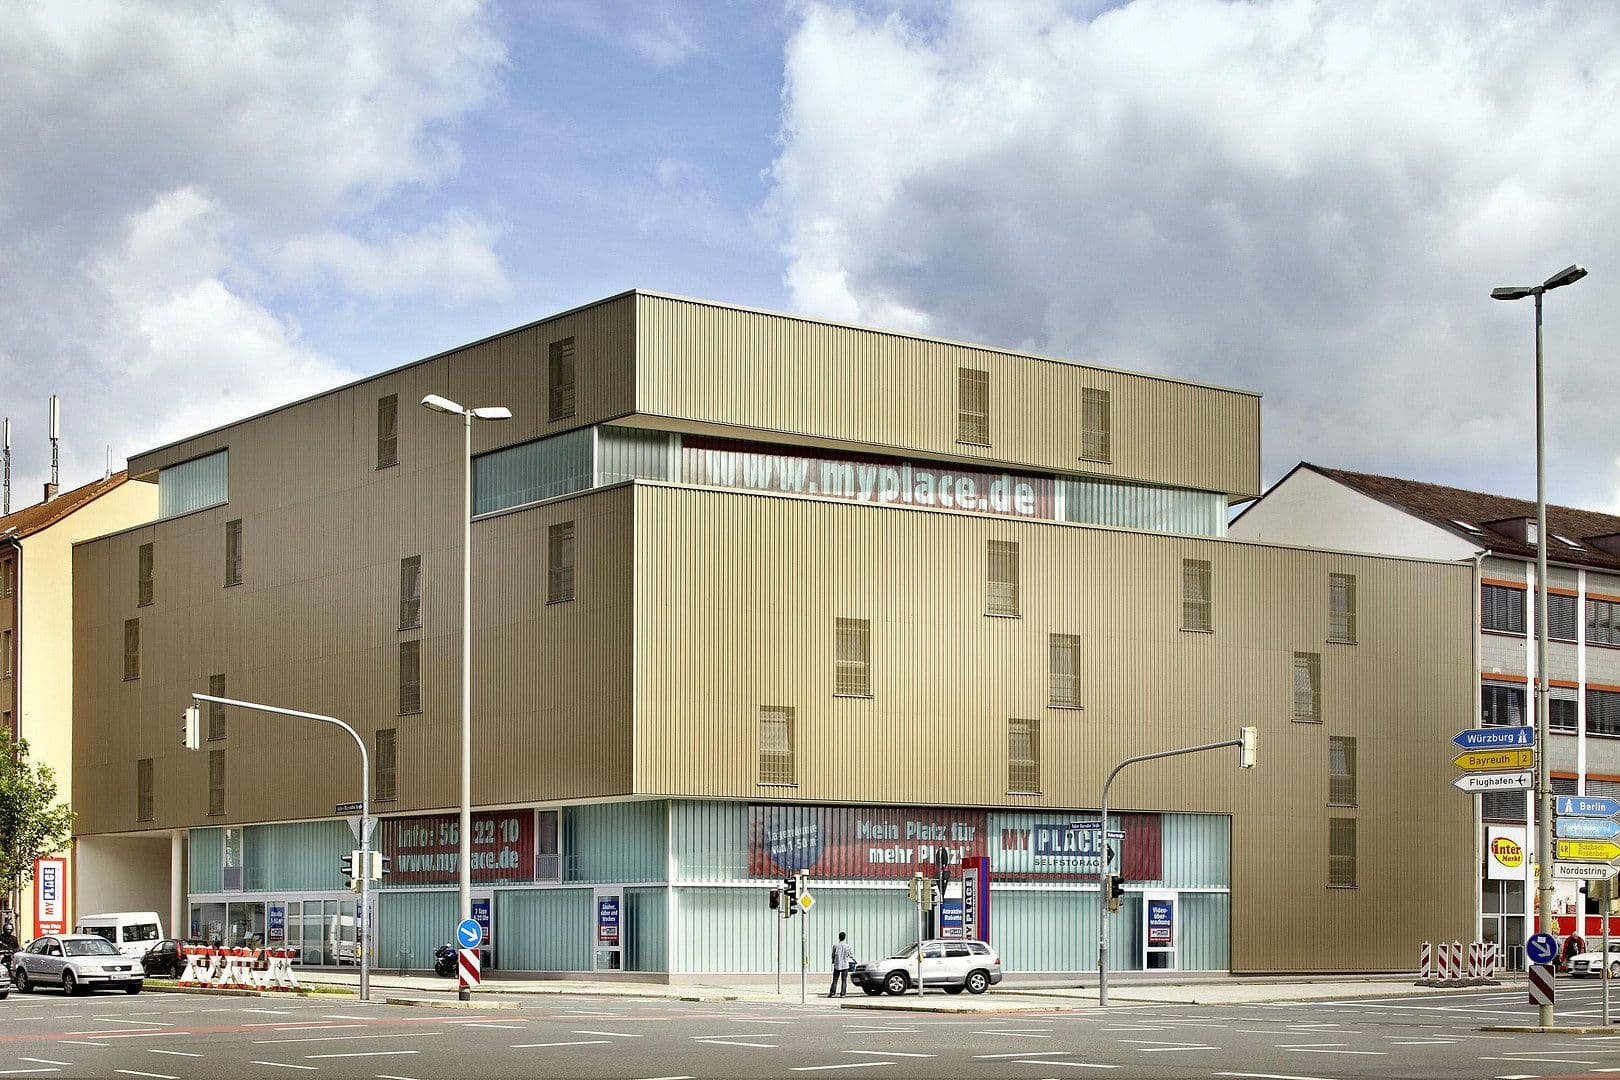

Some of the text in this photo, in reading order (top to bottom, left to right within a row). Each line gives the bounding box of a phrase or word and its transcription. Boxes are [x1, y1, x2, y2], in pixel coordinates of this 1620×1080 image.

[704, 448, 1036, 515] www.myplace.de
[1467, 734, 1514, 743] Würzburg
[1469, 754, 1528, 766] Bayreuth 2
[1469, 777, 1514, 788] Flughafen
[1580, 801, 1606, 811] Berlin
[398, 823, 434, 848] Info:
[474, 820, 495, 844] 22
[500, 818, 520, 843] 10
[857, 820, 976, 841] Mein Platz für
[1001, 829, 1102, 852] MY PLACE
[1493, 841, 1521, 855] inter
[1578, 843, 1605, 851] Sulzbach-
[398, 845, 519, 873] www.myace.de
[869, 844, 914, 864] mehr
[1033, 858, 1100, 867] SELFSTORAG
[1560, 866, 1607, 877] Nordostring
[44, 867, 55, 916] MY PLACE
[965, 879, 973, 922] PLACE
